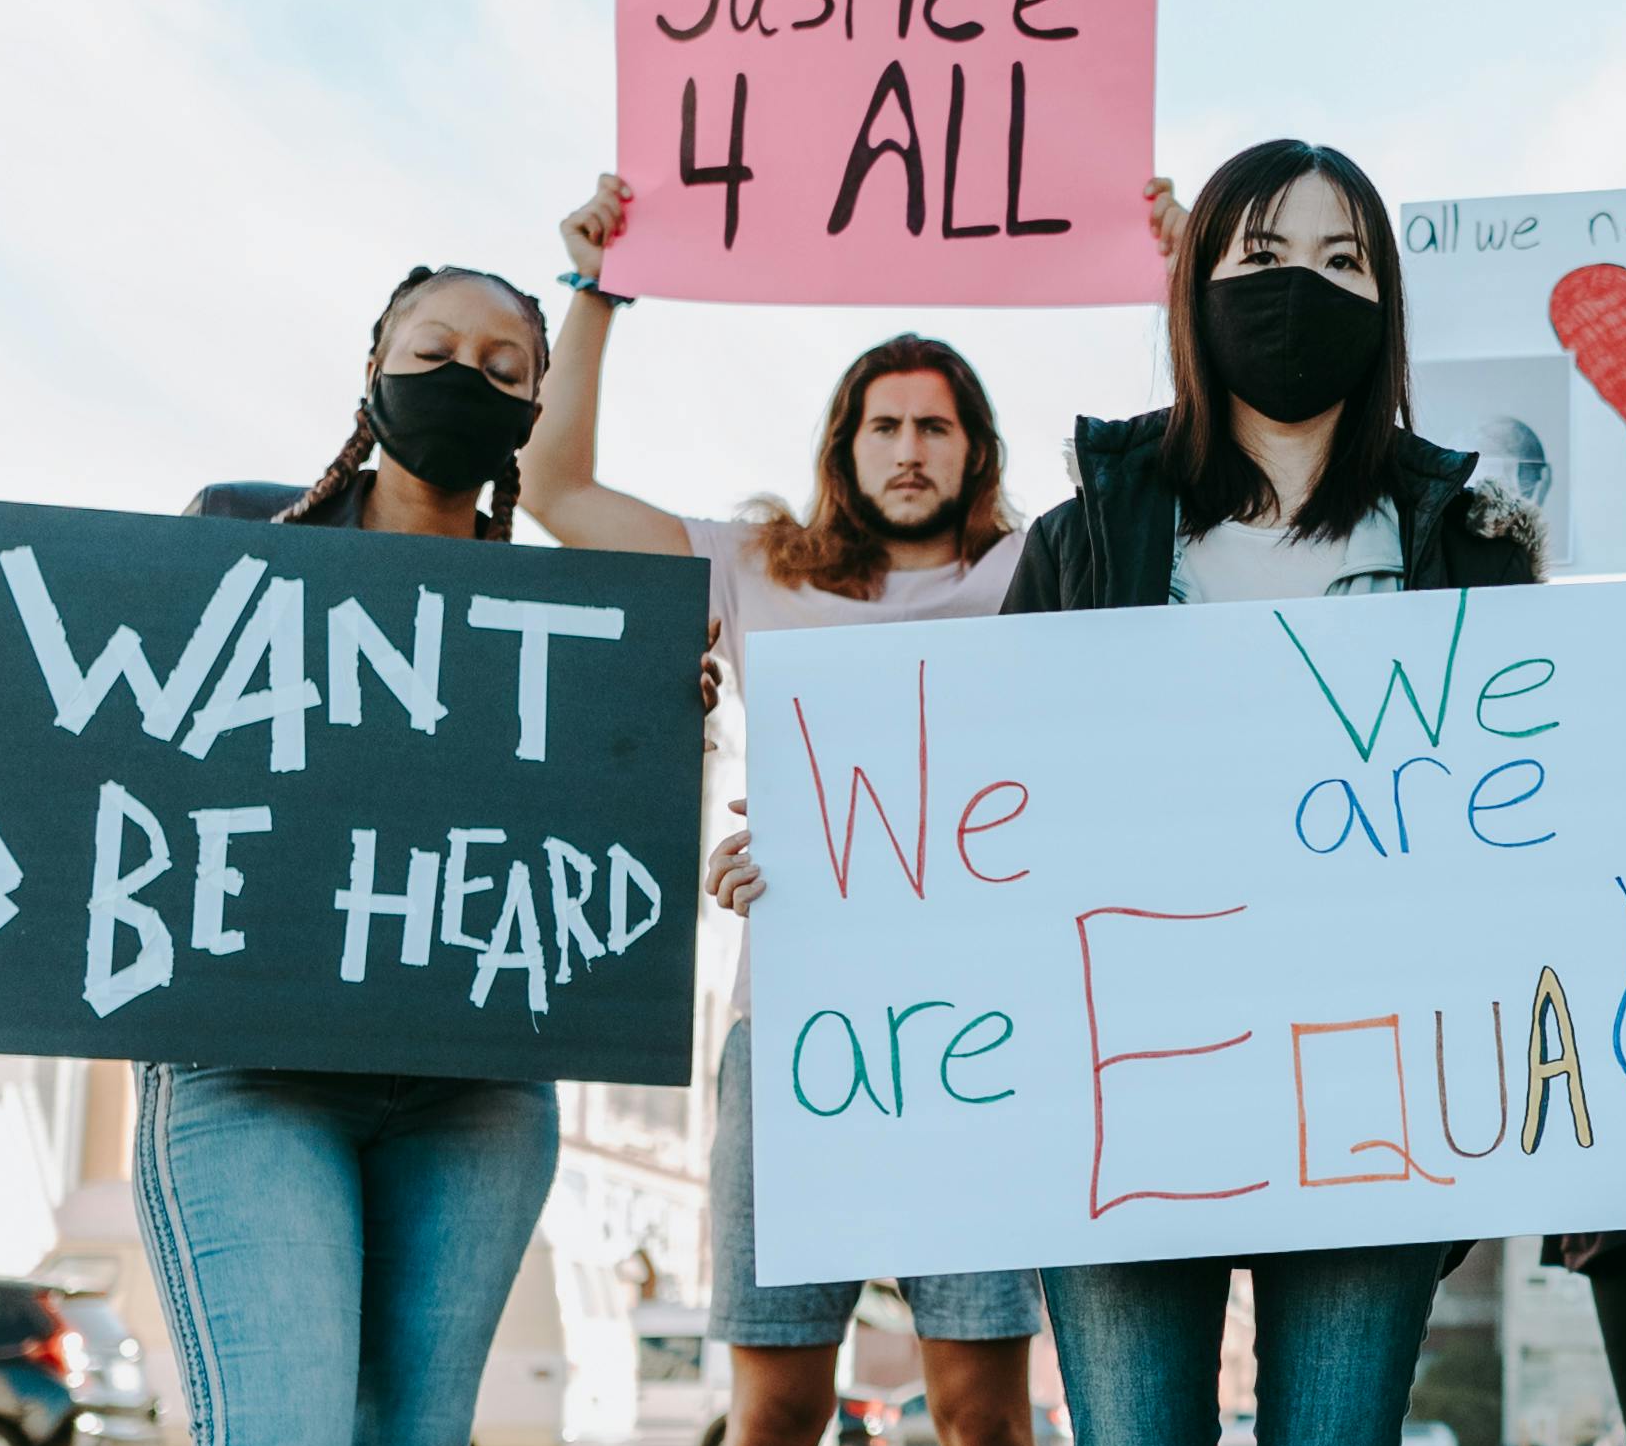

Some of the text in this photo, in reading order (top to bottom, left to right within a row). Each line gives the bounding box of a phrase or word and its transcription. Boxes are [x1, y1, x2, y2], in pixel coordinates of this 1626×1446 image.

[680, 59, 1072, 250] 4 ALL
[1405, 202, 1460, 255] all
[1475, 215, 1541, 253] we
[0, 544, 626, 773] WANT
[1273, 588, 1561, 763] We
[792, 659, 1031, 900] We
[1295, 757, 1557, 858] are
[82, 780, 273, 1019] BE
[334, 827, 662, 1017] HEARD
[791, 1000, 1016, 1119] are
